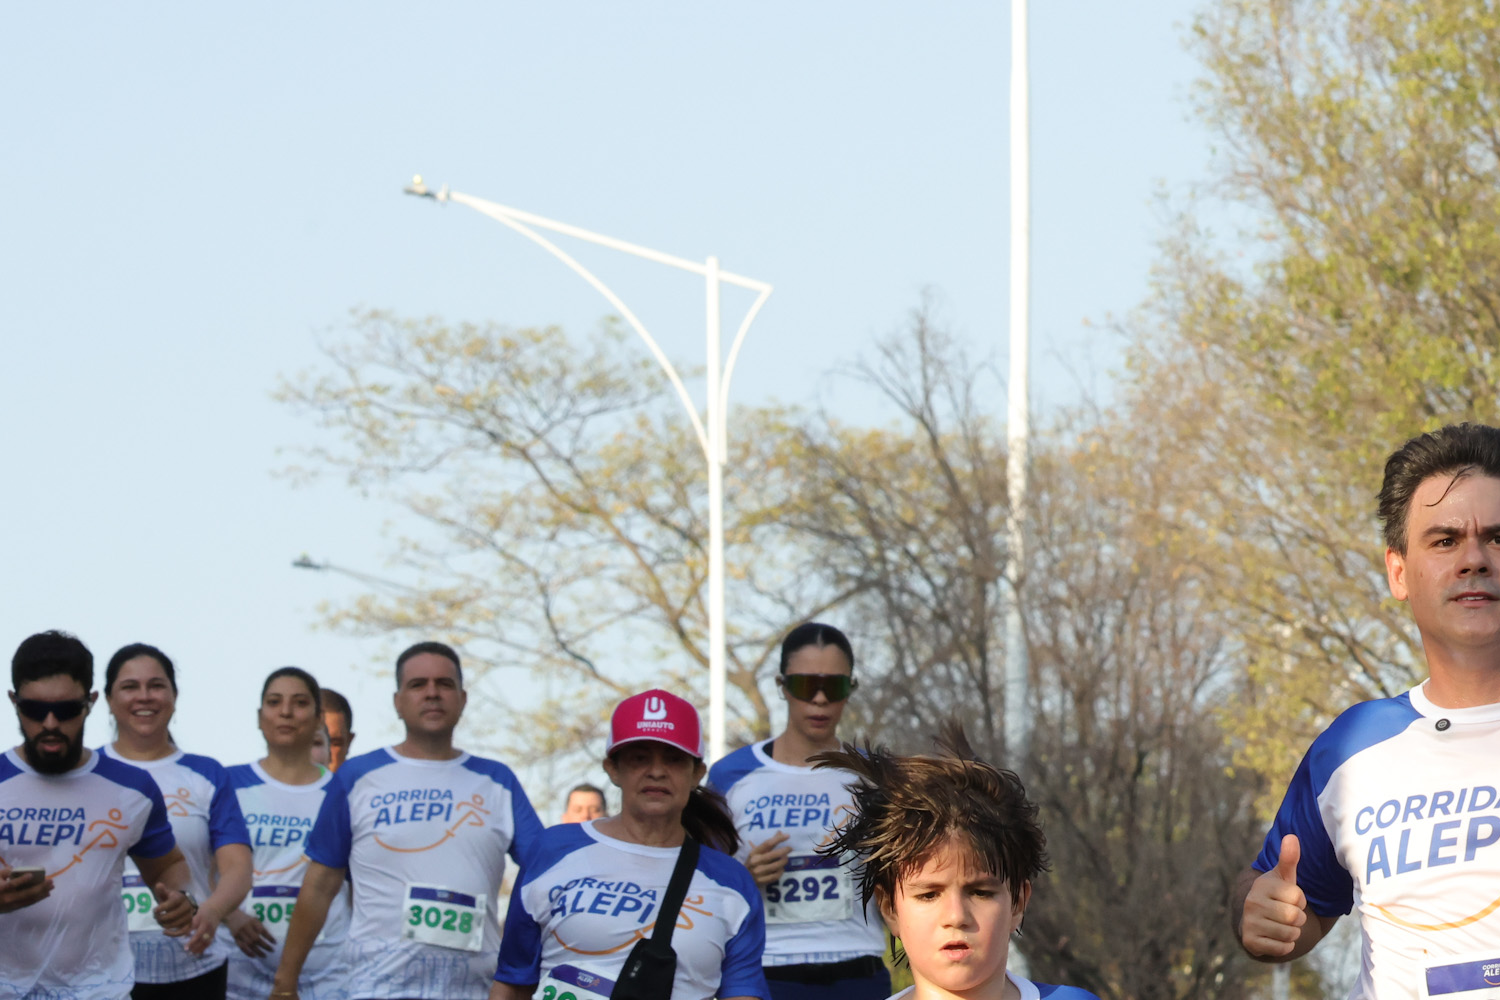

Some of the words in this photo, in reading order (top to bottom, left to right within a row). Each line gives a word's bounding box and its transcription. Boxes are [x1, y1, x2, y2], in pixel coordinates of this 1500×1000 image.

[369, 788, 454, 808] CORRIDA
[744, 793, 831, 815] CORRIDA
[246, 813, 312, 828] ORRIDA
[373, 803, 454, 829] ALEPI
[748, 808, 831, 832] ALEPI
[0, 823, 85, 846] ALEPI
[254, 828, 312, 848] LEPI
[549, 876, 658, 903] CORRIDA
[765, 875, 840, 903] 5292
[551, 890, 655, 924] ALEPI
[408, 905, 474, 934] 3028
